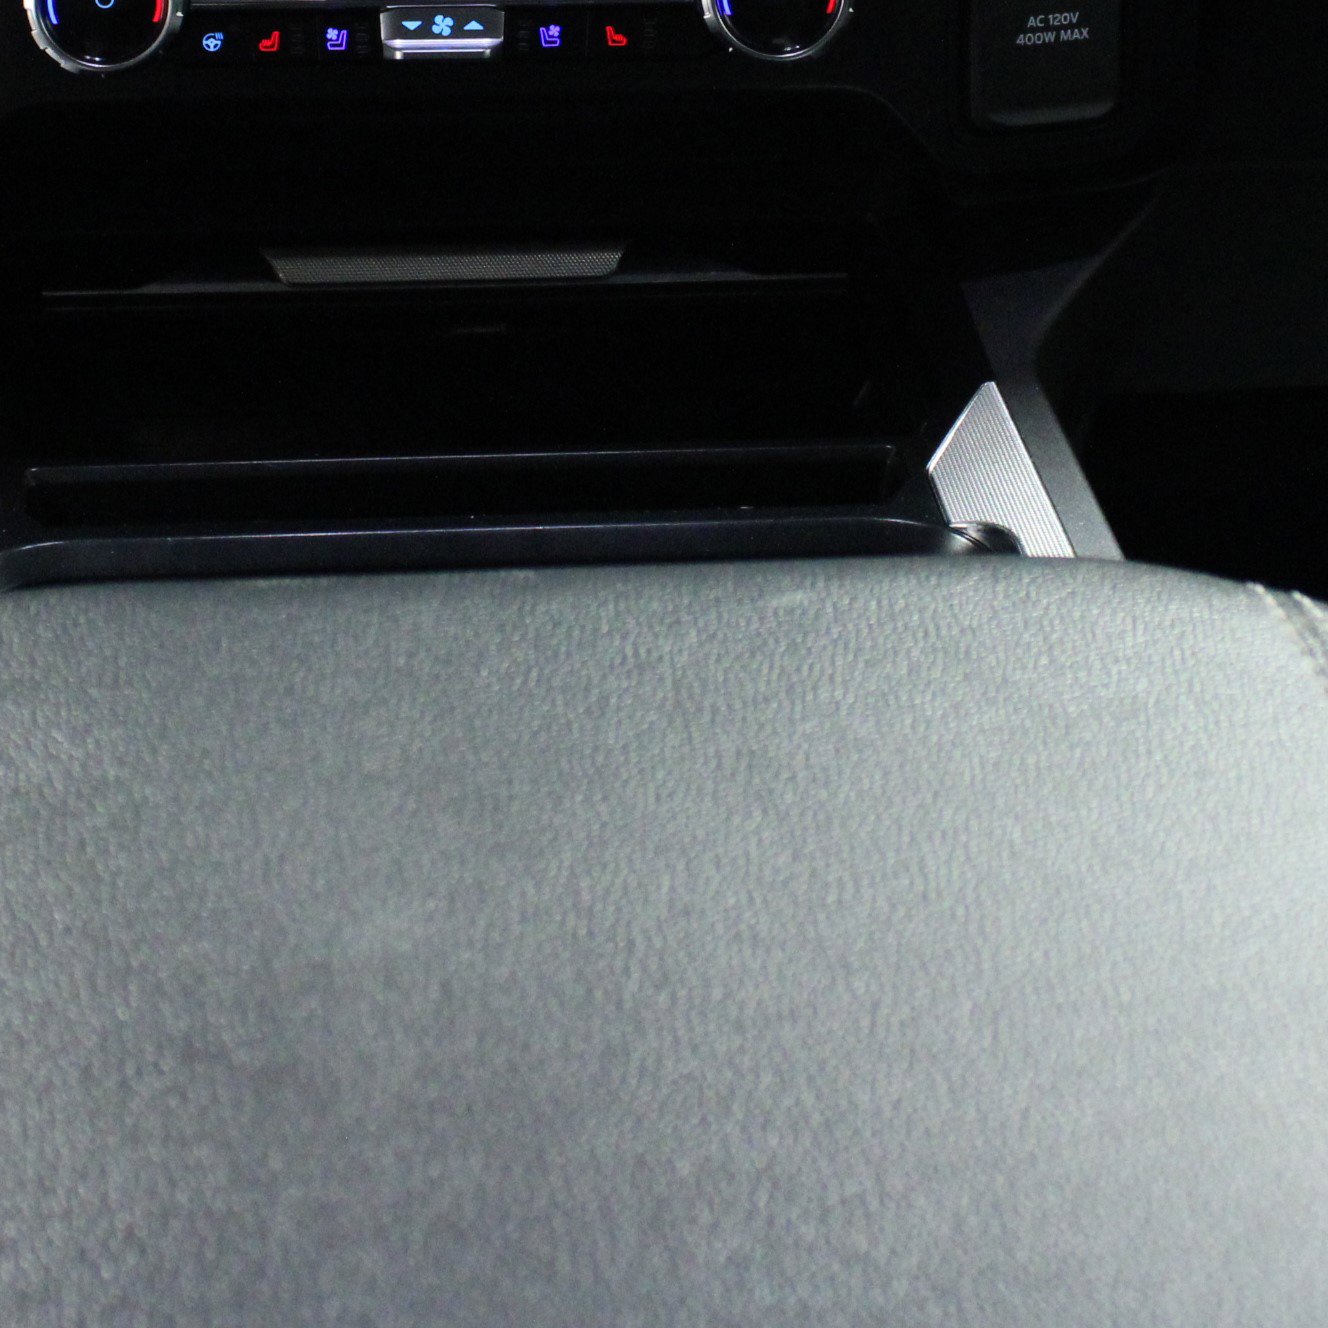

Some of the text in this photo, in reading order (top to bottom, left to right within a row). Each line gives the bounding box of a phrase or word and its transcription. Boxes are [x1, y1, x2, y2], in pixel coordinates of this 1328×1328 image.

[1026, 11, 1080, 29] AC 120V
[1015, 27, 1090, 46] 400W MAX
